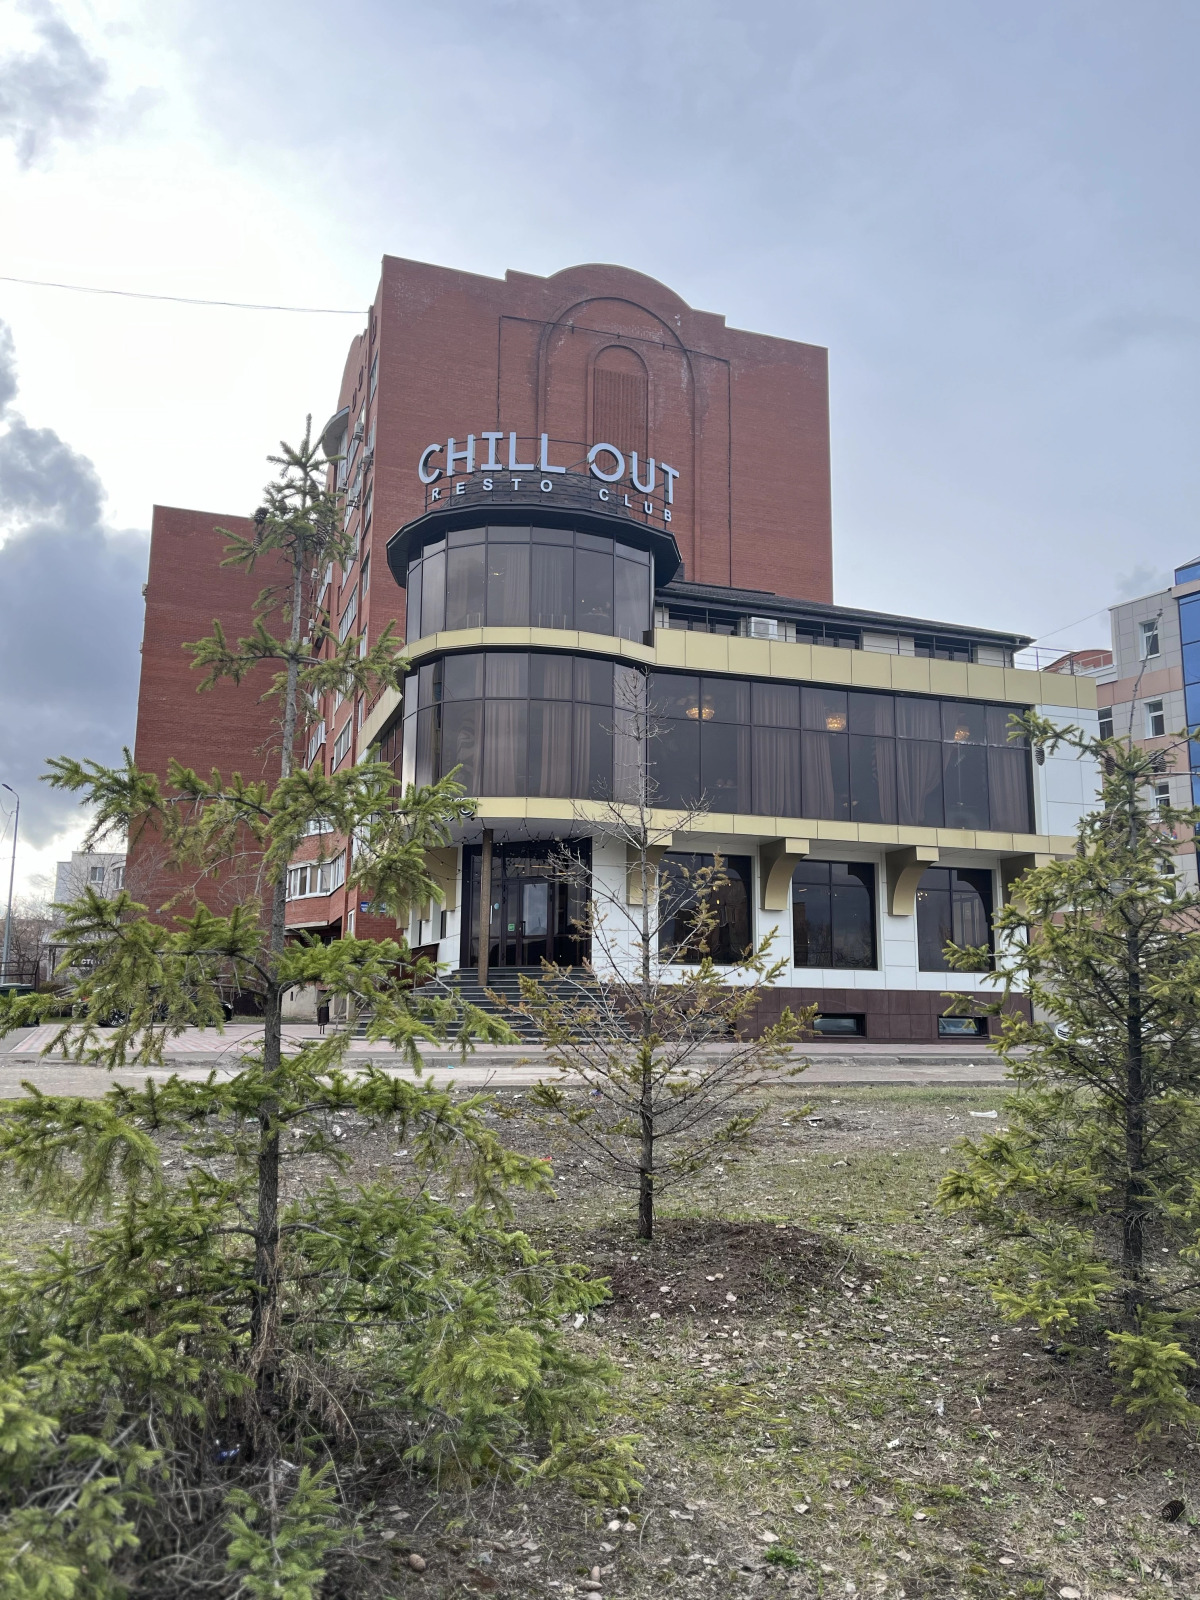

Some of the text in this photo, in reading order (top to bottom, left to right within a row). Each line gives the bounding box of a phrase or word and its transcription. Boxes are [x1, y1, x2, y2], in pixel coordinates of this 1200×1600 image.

[418, 432, 680, 505] CHILL OUT
[431, 478, 672, 522] RESTO CLUB
